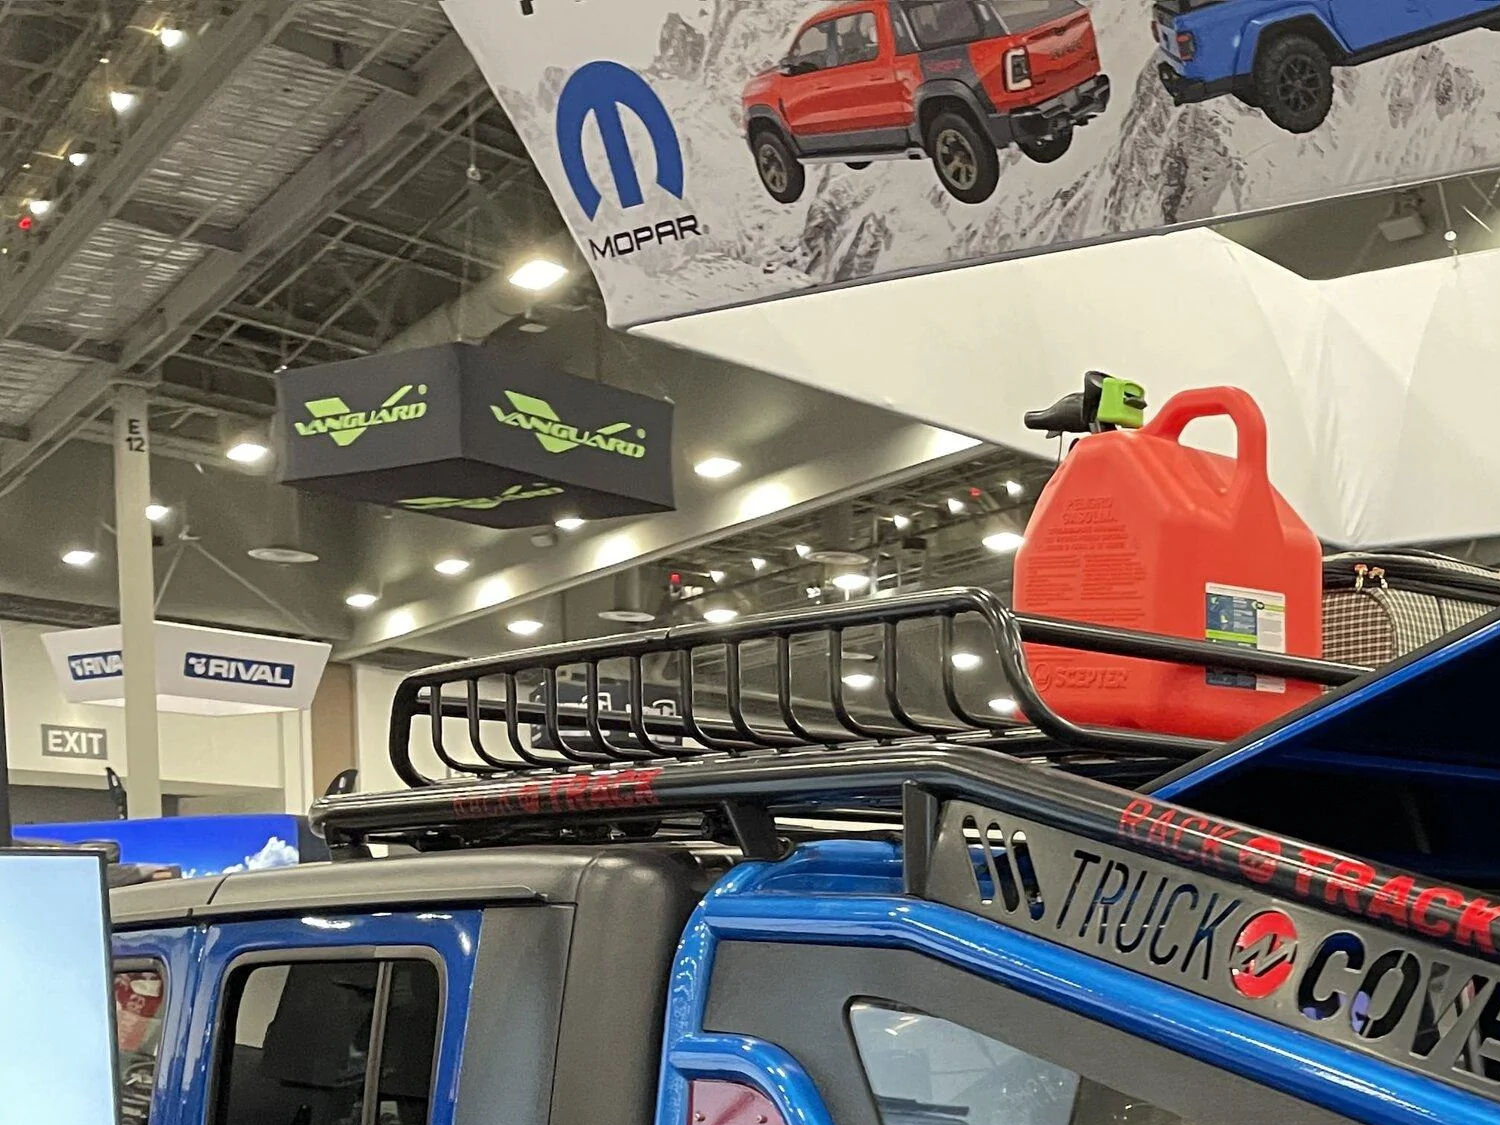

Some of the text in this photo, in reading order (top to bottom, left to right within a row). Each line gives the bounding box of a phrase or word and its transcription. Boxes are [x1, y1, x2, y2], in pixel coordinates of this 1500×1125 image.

[588, 214, 702, 260] MOPAR
[128, 418, 141, 435] E
[294, 402, 427, 436] VANGUARD
[490, 405, 645, 458] VANGUARD
[125, 436, 145, 453] 12
[83, 653, 124, 676] RIVA
[207, 658, 291, 686] RIVAL
[47, 730, 103, 755] EXIT
[1116, 798, 1240, 868] RACK
[1055, 849, 1242, 982] TRUCK
